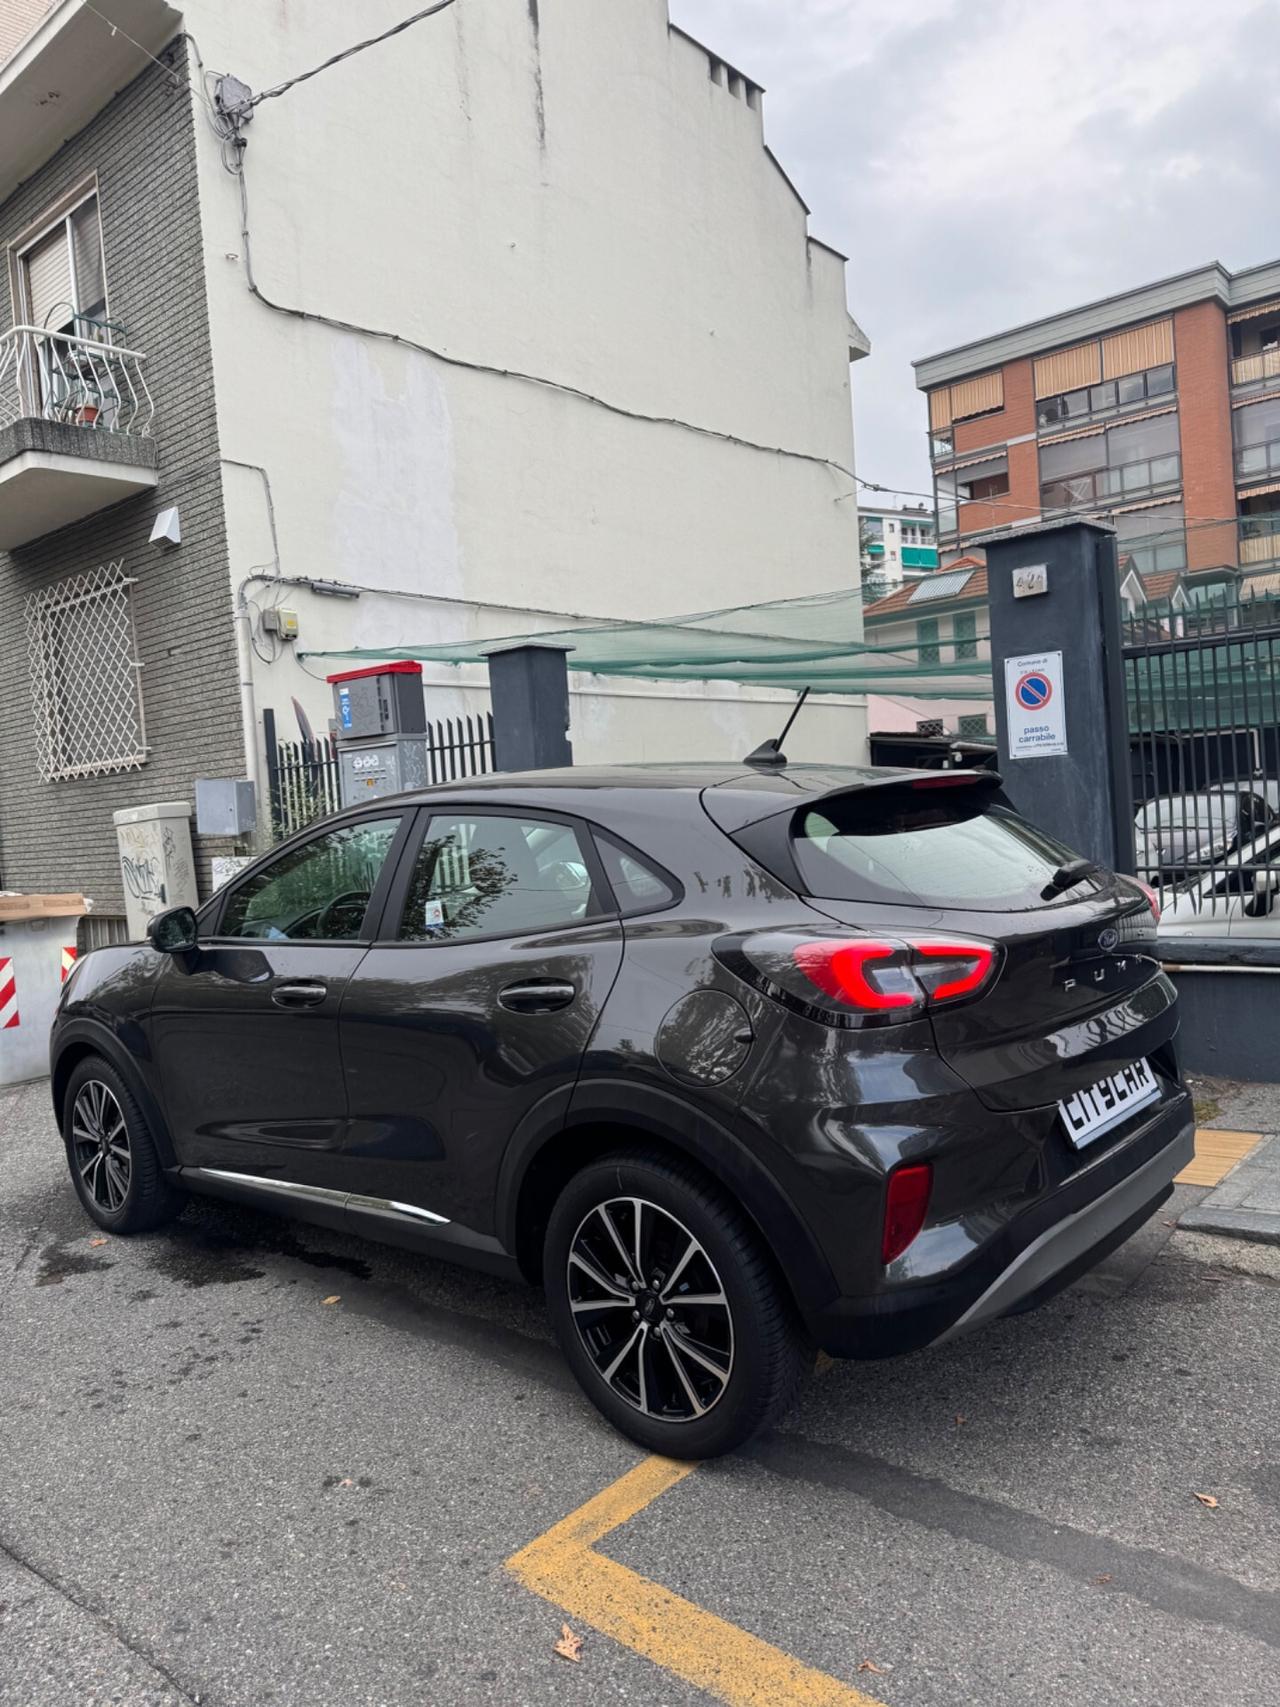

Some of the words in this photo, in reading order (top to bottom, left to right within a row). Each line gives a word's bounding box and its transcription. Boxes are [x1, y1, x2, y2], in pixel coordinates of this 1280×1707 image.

[1023, 725, 1050, 735] passo
[1018, 733, 1056, 743] carrabile
[1062, 1061, 1149, 1131] CITYCAR
